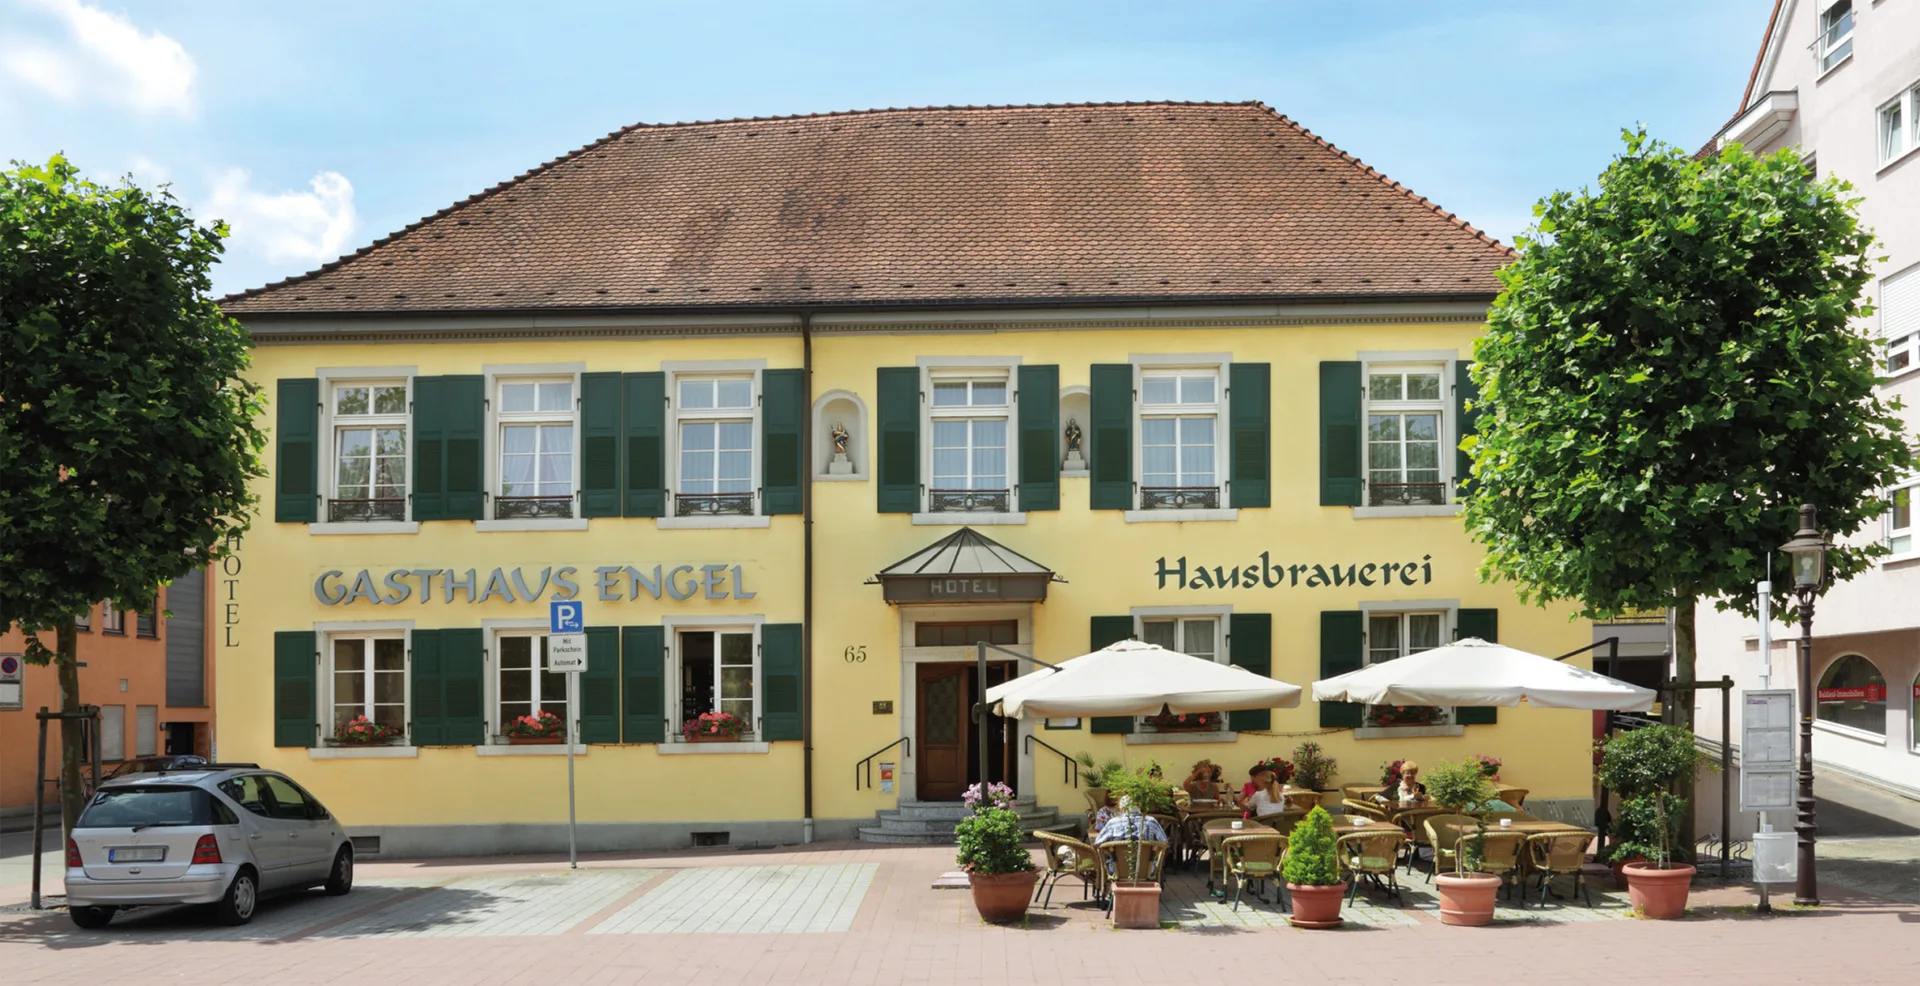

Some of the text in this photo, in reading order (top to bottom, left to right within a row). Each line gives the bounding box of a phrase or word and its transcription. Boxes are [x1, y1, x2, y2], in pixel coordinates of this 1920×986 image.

[314, 564, 757, 605] GASTHAUS ENGEL
[1154, 551, 1432, 590] Hausbrauerei
[224, 532, 241, 647] HOTEL
[931, 580, 997, 593] HOTEL
[557, 605, 575, 629] P
[844, 645, 867, 663] 65
